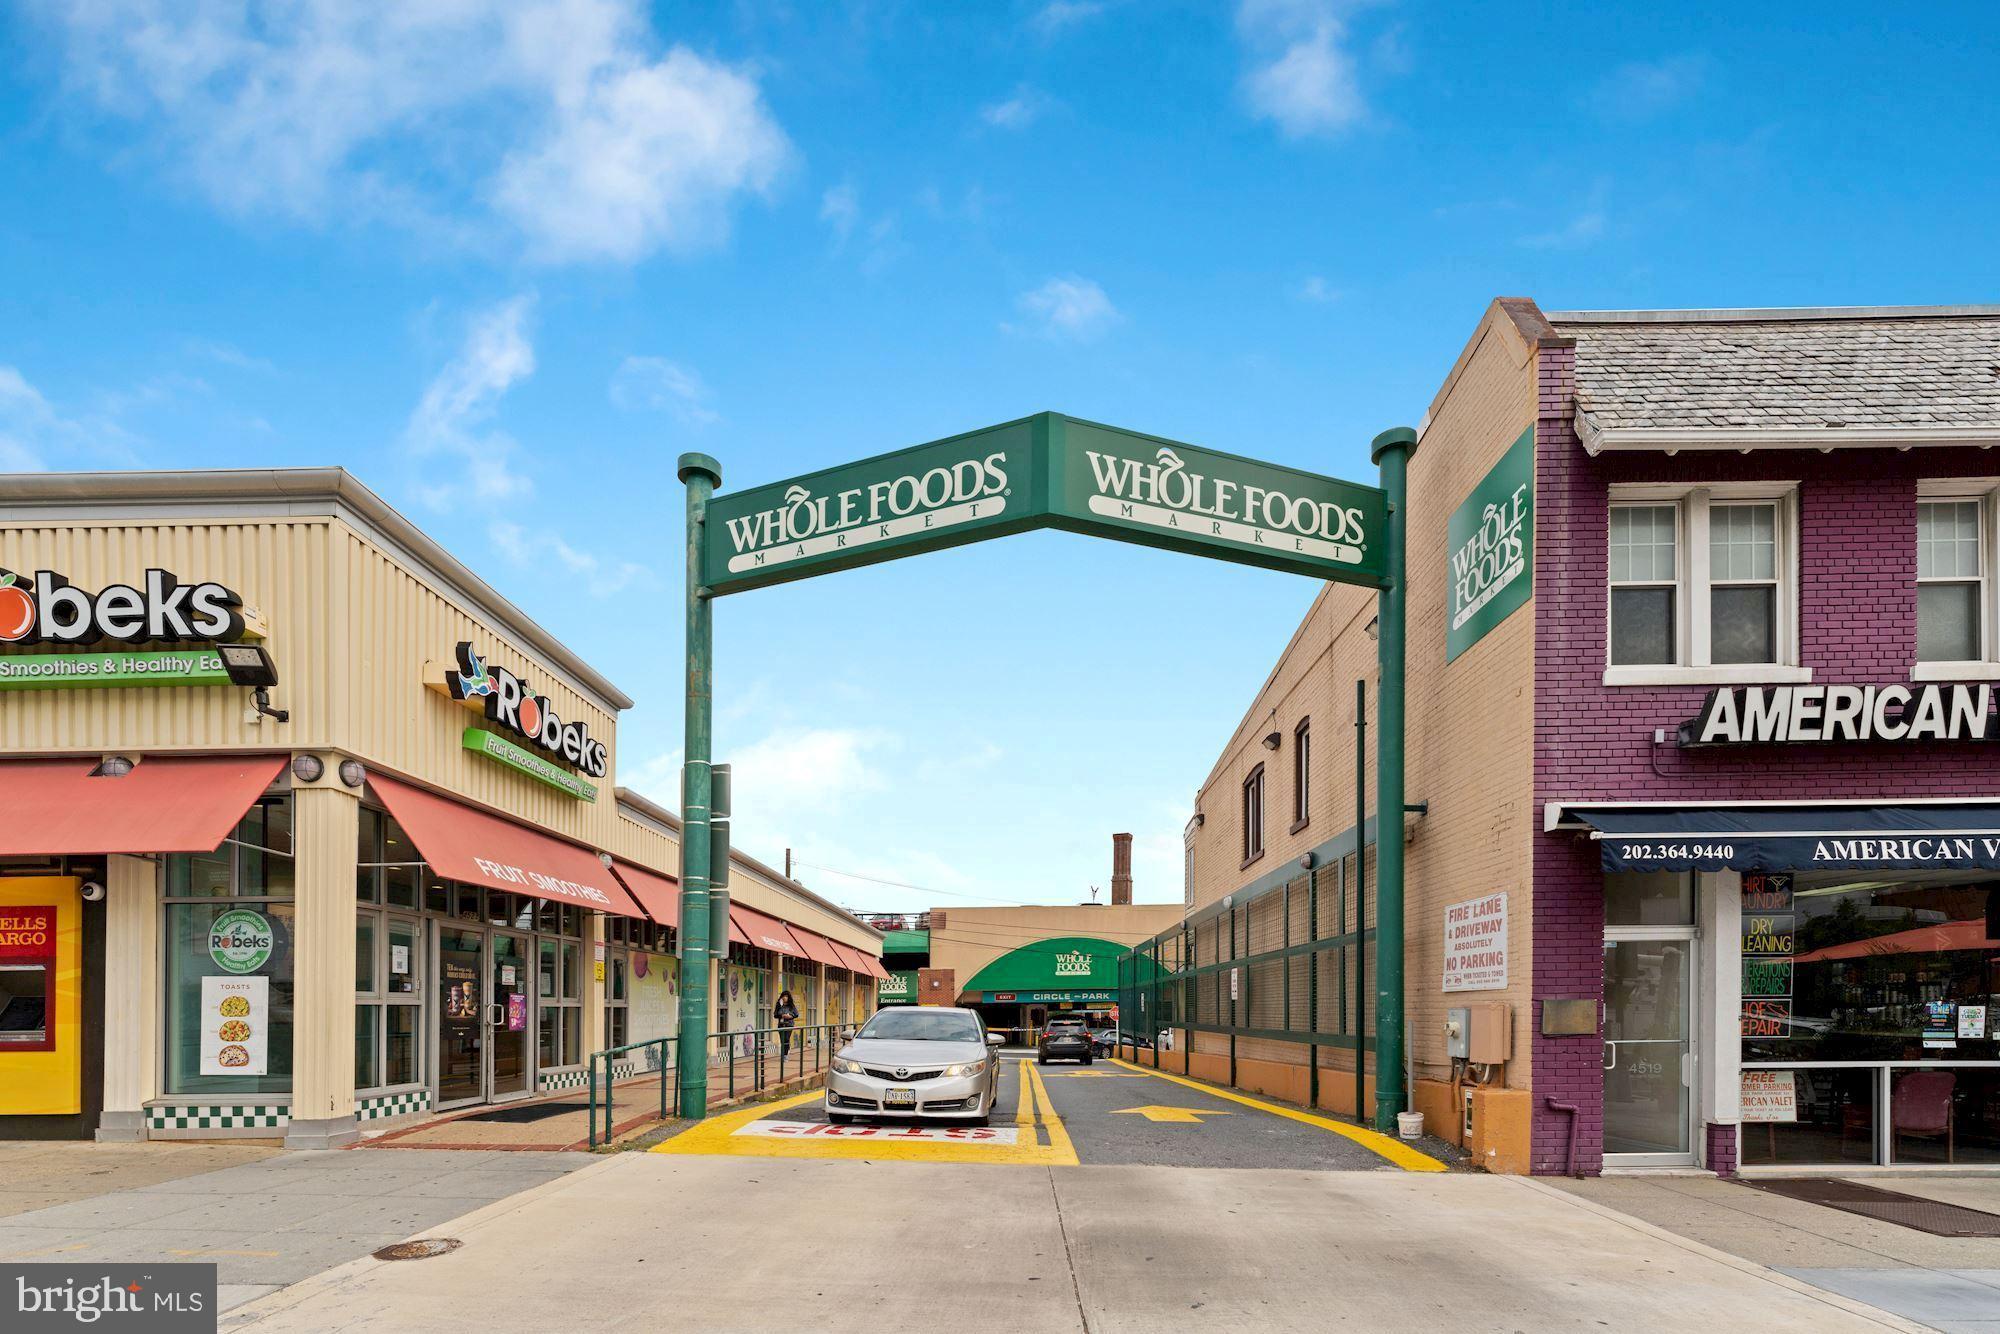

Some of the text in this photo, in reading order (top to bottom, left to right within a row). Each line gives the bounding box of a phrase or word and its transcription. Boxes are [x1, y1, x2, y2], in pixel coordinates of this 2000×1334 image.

[726, 452, 1008, 552] WHOLE FOODS
[1086, 447, 1364, 545] WHOLE FOODS
[755, 503, 979, 564] MARKET
[1121, 503, 1342, 558] MARKET
[1452, 483, 1527, 582] WHOLE
[1455, 522, 1523, 614] FOODS
[0, 569, 231, 640] obeks
[1457, 564, 1519, 625] MARKET
[0, 656, 224, 677] Smoothies & Healthy Ea
[496, 668, 608, 778] Robeks
[1700, 683, 1991, 743] AMERICAN
[487, 738, 507, 758] Fruit
[507, 747, 551, 777] Smoothies
[1622, 838, 2000, 862] 202.364.9440 AMERICAN V
[473, 856, 611, 905] FRUIT SMOOTHIES
[1449, 898, 1502, 923] FIRE LANE
[0, 917, 47, 930] ELLS
[1448, 918, 1503, 939] & DRIVEWAY
[1751, 919, 1775, 935] DRY
[0, 933, 47, 946] ARGO
[212, 935, 269, 949] Robeks
[1454, 938, 1493, 951] ABSOLUTELY
[1741, 936, 1792, 952] LEANING
[1055, 950, 1092, 963] WHOLE
[1446, 951, 1504, 971] NO PARKING
[1055, 962, 1090, 972] FOODS
[880, 983, 907, 991] FOODS
[1750, 978, 1786, 995] REPAIRS
[1741, 1019, 1781, 1036] EPAIR
[1629, 1063, 1662, 1073] 4519
[1743, 1073, 1776, 1083] FREE
[1763, 1082, 1793, 1091] PARKING
[1741, 1096, 1793, 1107] RICAN VALET
